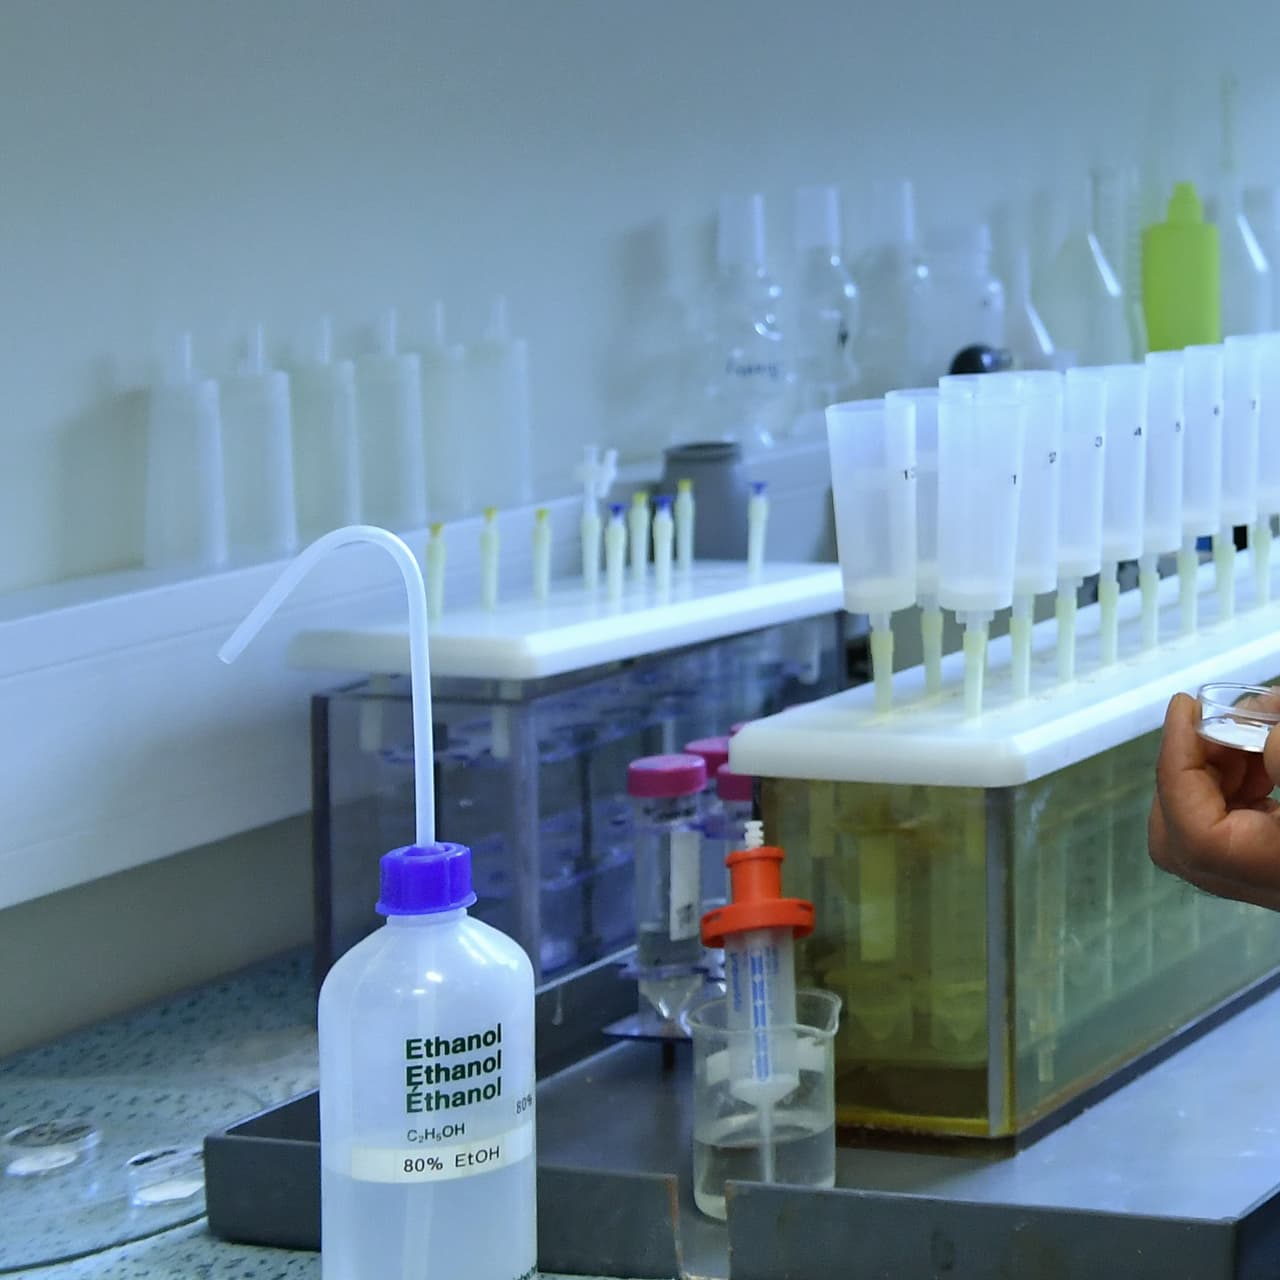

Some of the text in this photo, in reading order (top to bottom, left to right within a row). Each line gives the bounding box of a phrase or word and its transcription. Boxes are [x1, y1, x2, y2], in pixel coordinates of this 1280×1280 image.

[405, 1022, 502, 1060] Ethanol
[405, 1049, 502, 1087] Ethanol
[405, 1076, 502, 1114] Éthanol
[403, 1145, 501, 1173] 80% EtOH
